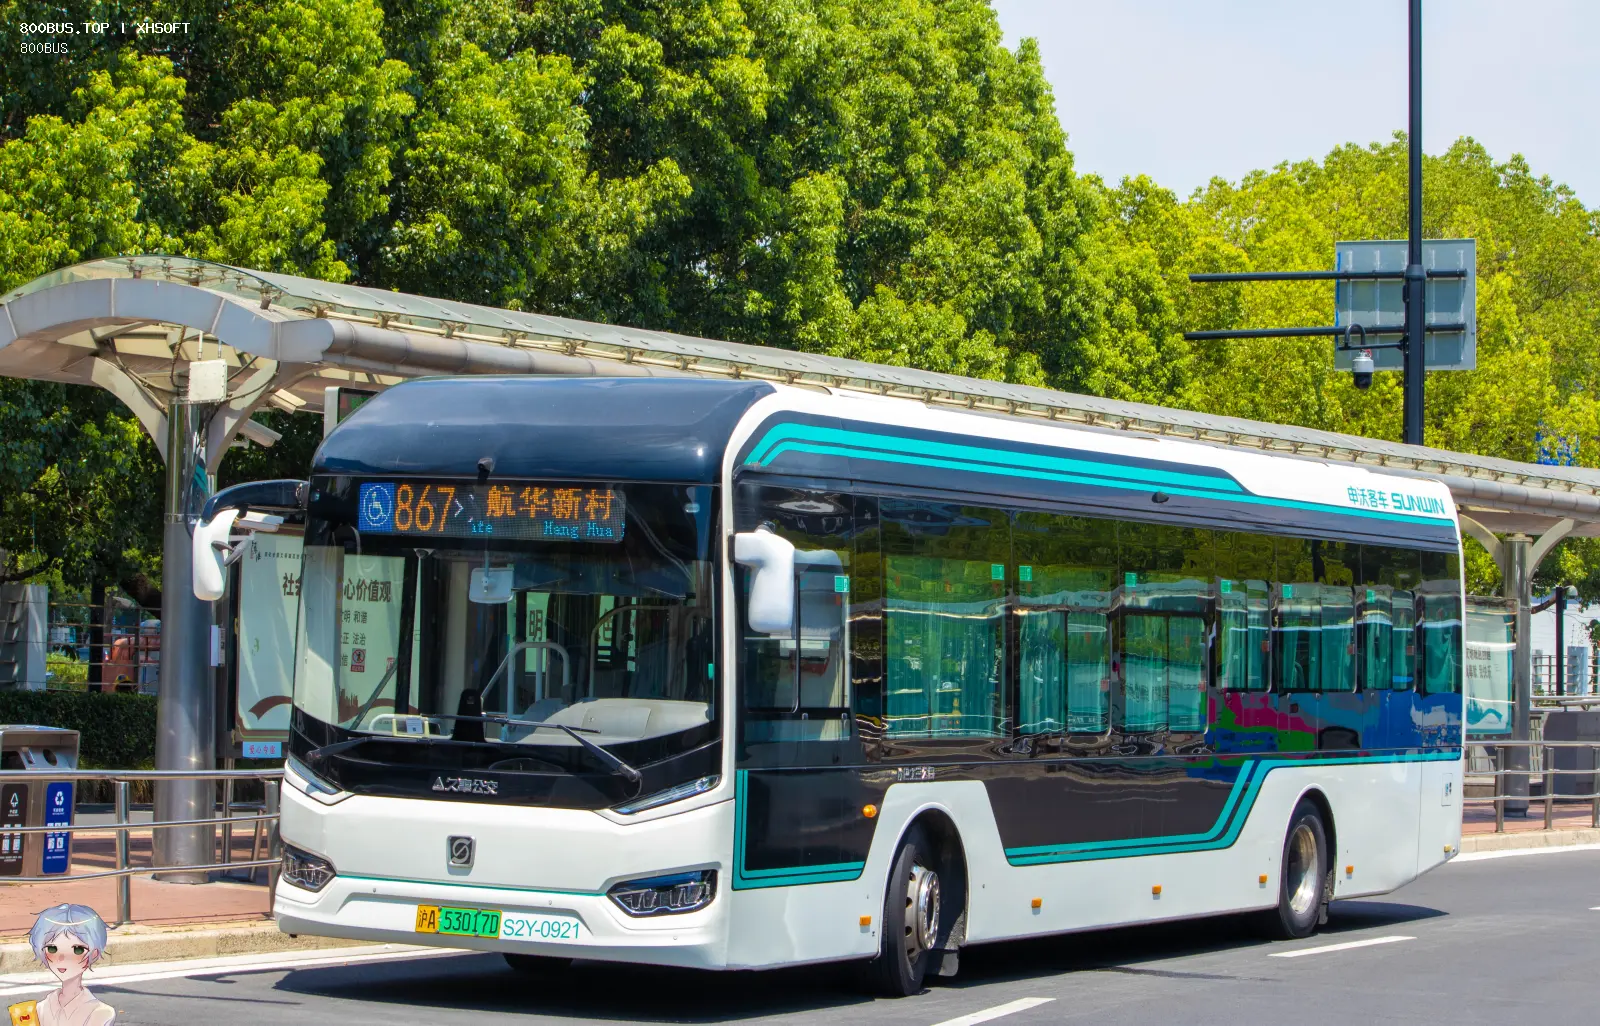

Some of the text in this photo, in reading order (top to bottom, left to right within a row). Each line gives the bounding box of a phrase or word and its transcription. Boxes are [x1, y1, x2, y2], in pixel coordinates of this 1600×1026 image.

[395, 484, 456, 532] 867
[486, 484, 615, 520] 航华新村
[1390, 492, 1446, 515] SUNWIN
[543, 520, 579, 539] Hang
[586, 521, 613, 537] Hua
[503, 918, 580, 939] S2Y-0921
